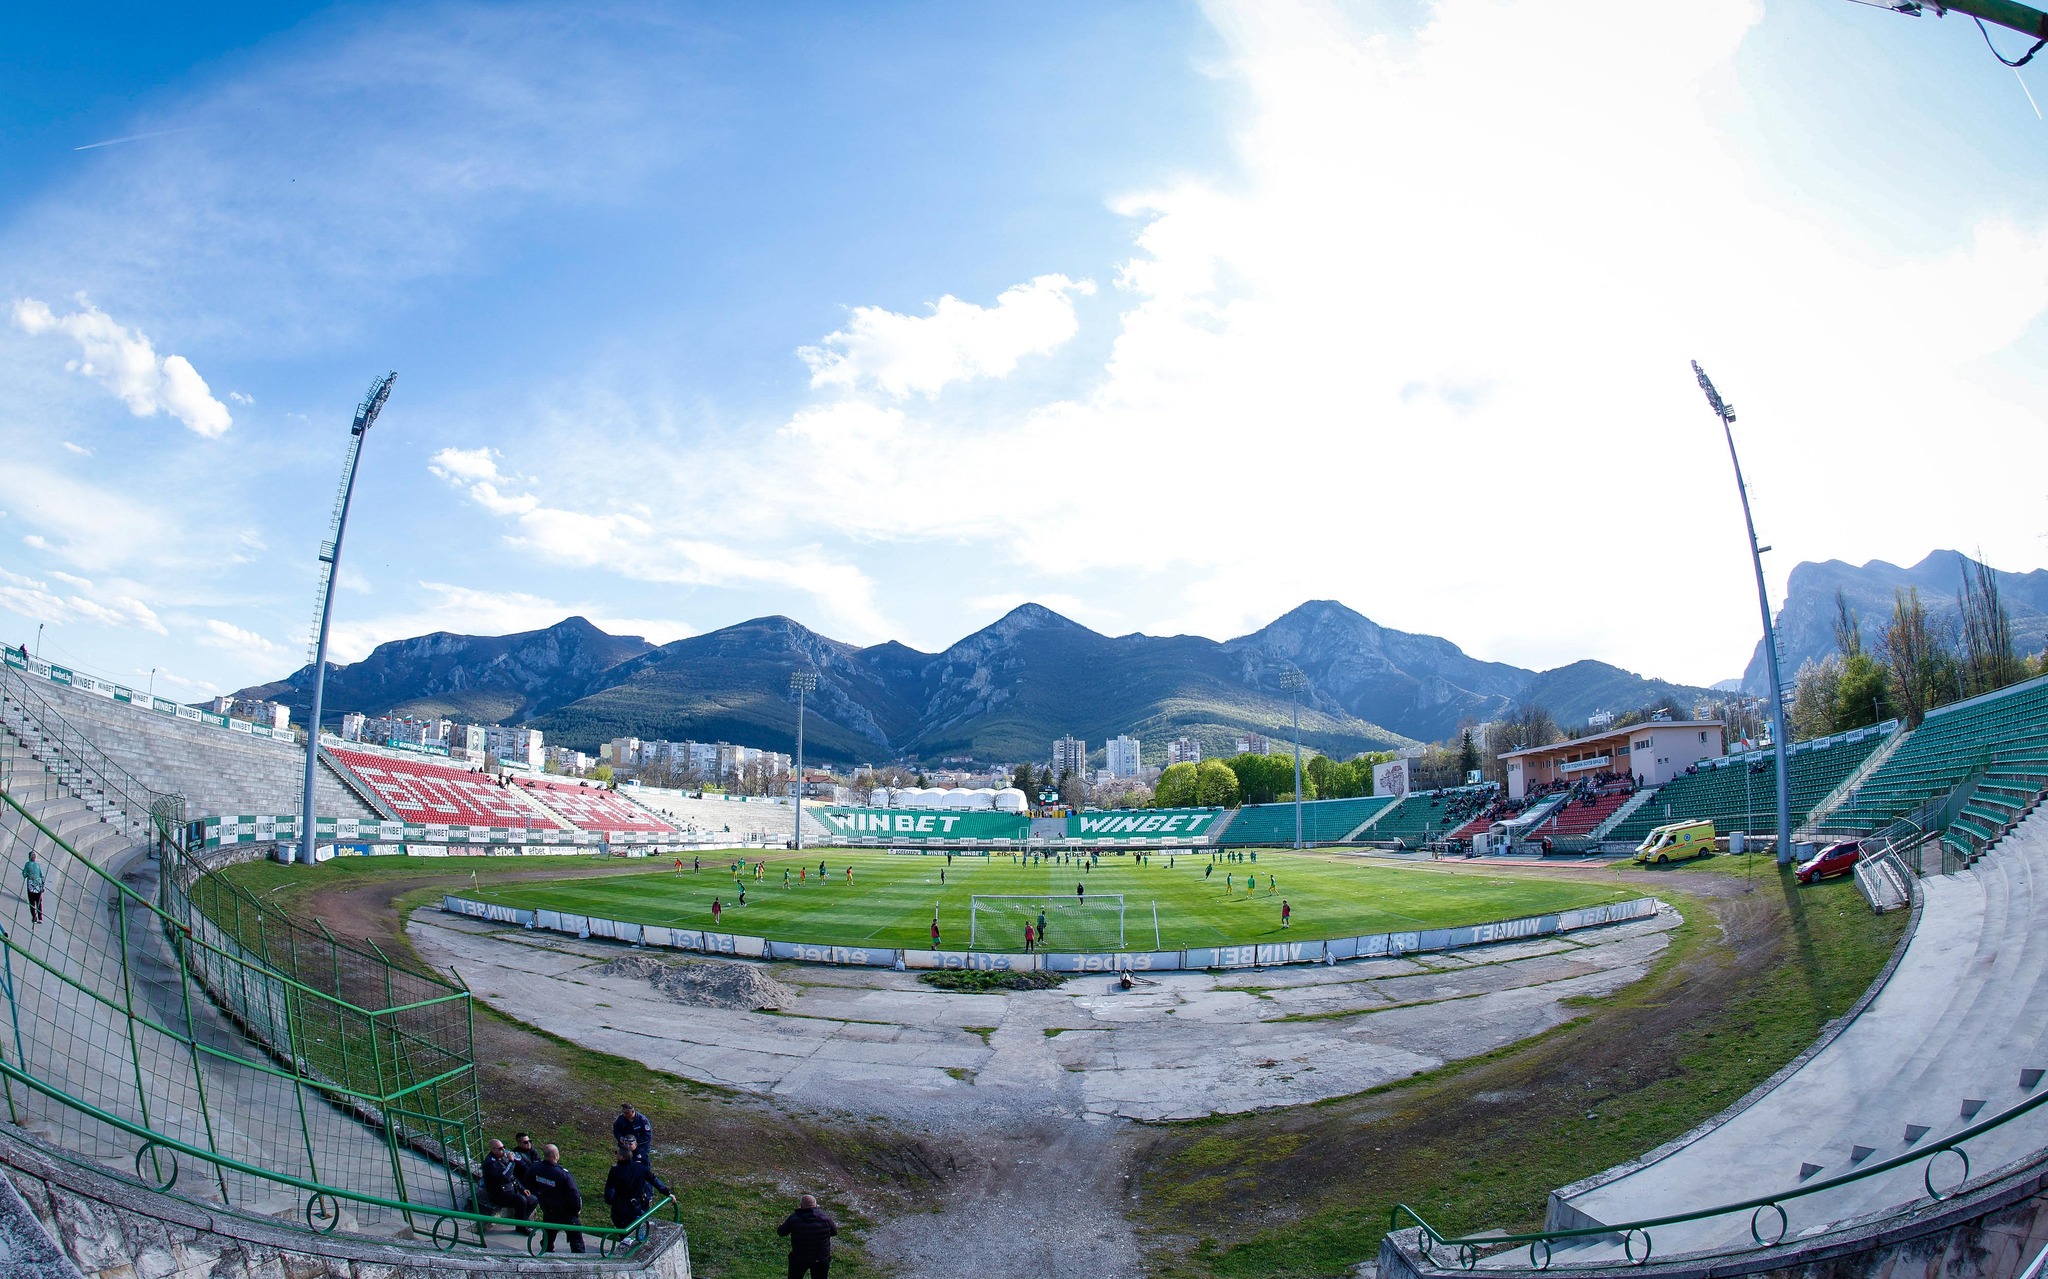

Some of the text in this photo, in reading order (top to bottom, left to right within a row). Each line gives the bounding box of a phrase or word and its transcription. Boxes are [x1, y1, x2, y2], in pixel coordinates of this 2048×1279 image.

[29, 660, 51, 678] WINBET
[73, 676, 95, 690] WINBET
[98, 682, 114, 693] WINBET
[133, 693, 148, 703] WINBET
[154, 699, 176, 714] WINBET
[178, 706, 200, 719] WINBET
[202, 712, 224, 726] WINBET
[231, 721, 251, 731] WINBET
[253, 725, 272, 736] WINBET
[1881, 722, 1896, 731] WINBET
[274, 730, 293, 741] WINBET
[323, 736, 343, 748] WINBET
[277, 822, 295, 833] WINBET
[824, 813, 960, 832] WINBET
[1080, 814, 1213, 833] WINBET
[221, 823, 238, 836] WINBET
[239, 823, 256, 834] WINBET
[257, 822, 275, 834] WINBET
[317, 823, 337, 833] WINBET
[338, 824, 359, 834] WINBET
[360, 824, 380, 834] WINBET
[381, 826, 402, 835] WINBET
[404, 827, 425, 836] WINBET
[426, 829, 448, 837] WINBET
[449, 830, 469, 838] WINBET
[471, 830, 489, 838] WINBET
[491, 831, 508, 839] WINBET
[373, 845, 400, 855] WINBET
[494, 847, 515, 855] efbet
[528, 847, 546, 855] efbet
